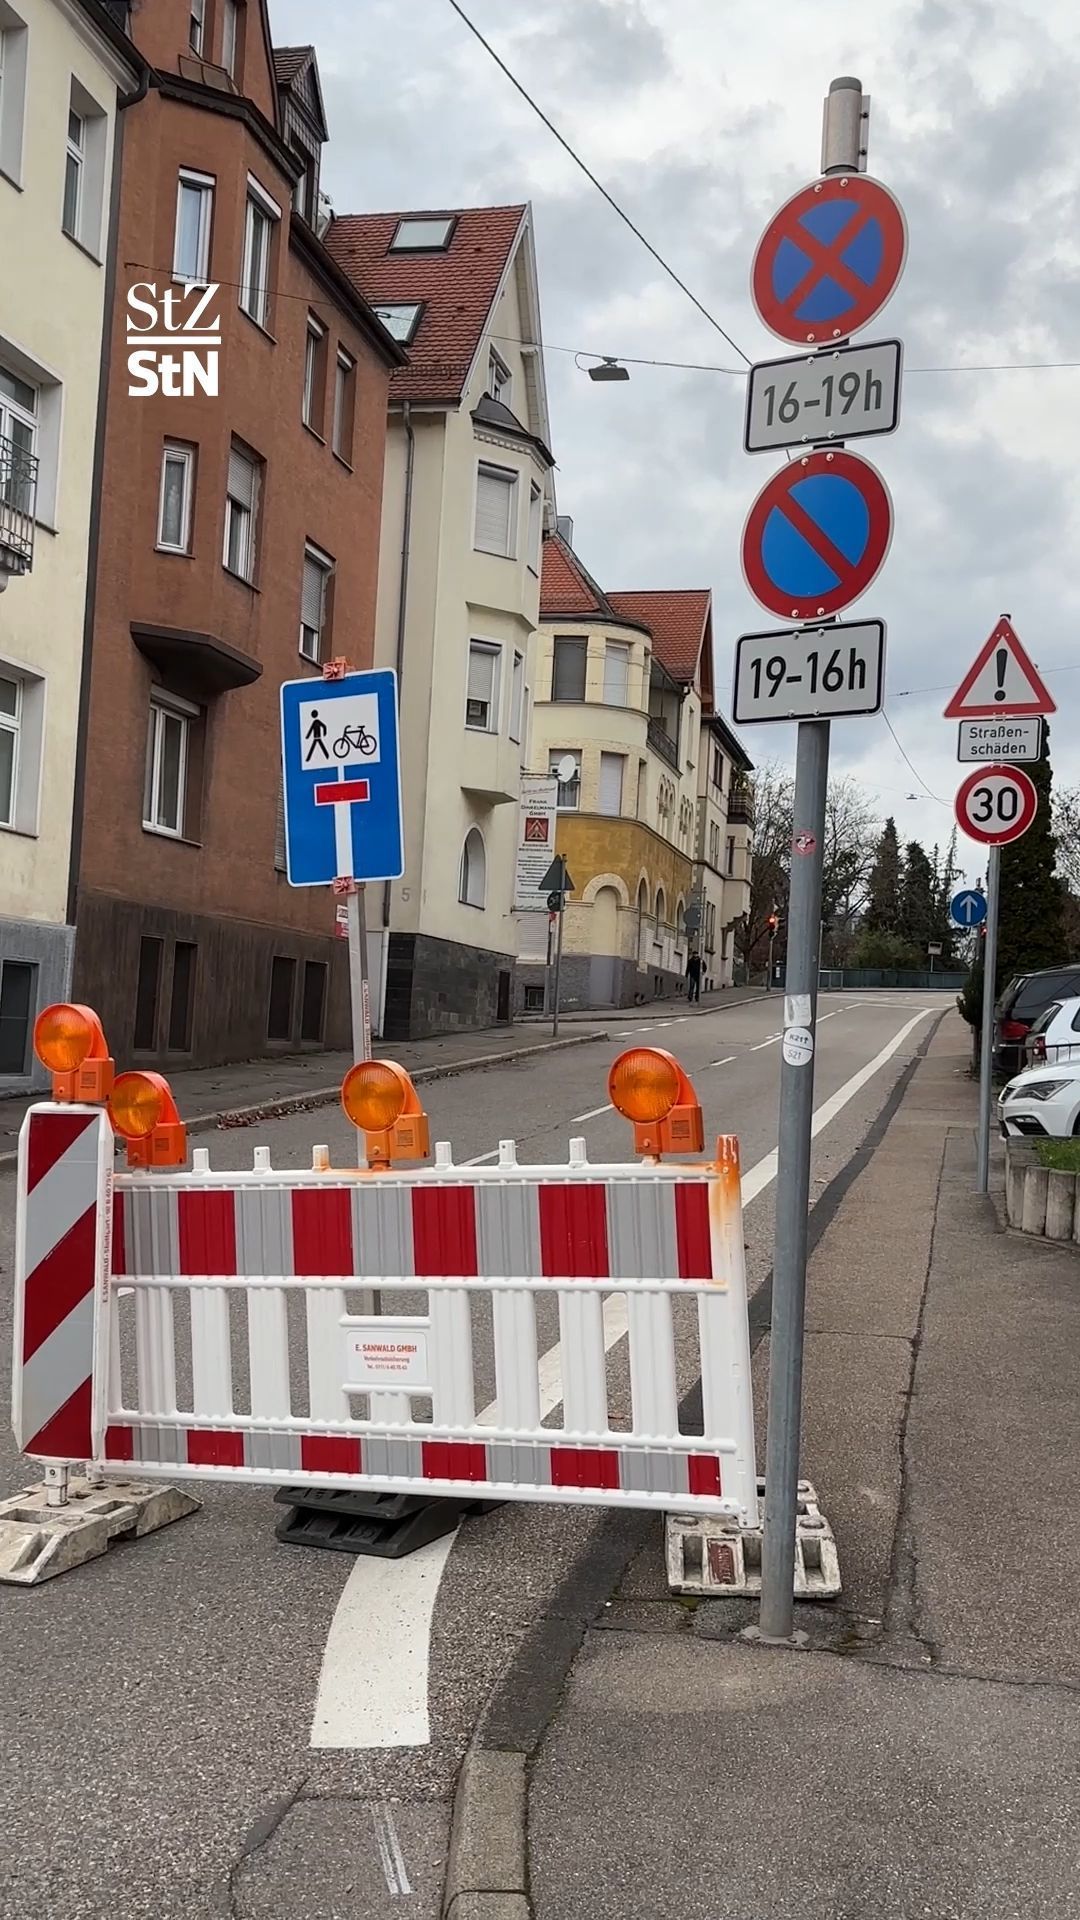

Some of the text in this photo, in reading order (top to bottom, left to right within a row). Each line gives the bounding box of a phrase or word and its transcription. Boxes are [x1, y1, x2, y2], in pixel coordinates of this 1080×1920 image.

[763, 368, 882, 427] 16-19h
[750, 646, 866, 699] 19-16h
[969, 725, 1030, 740] Straßen-
[970, 742, 1027, 756] schäden
[972, 786, 1018, 823] 30
[401, 887, 411, 902] 5
[362, 1344, 396, 1352] SANWALD
[397, 1345, 418, 1353] GMBH
